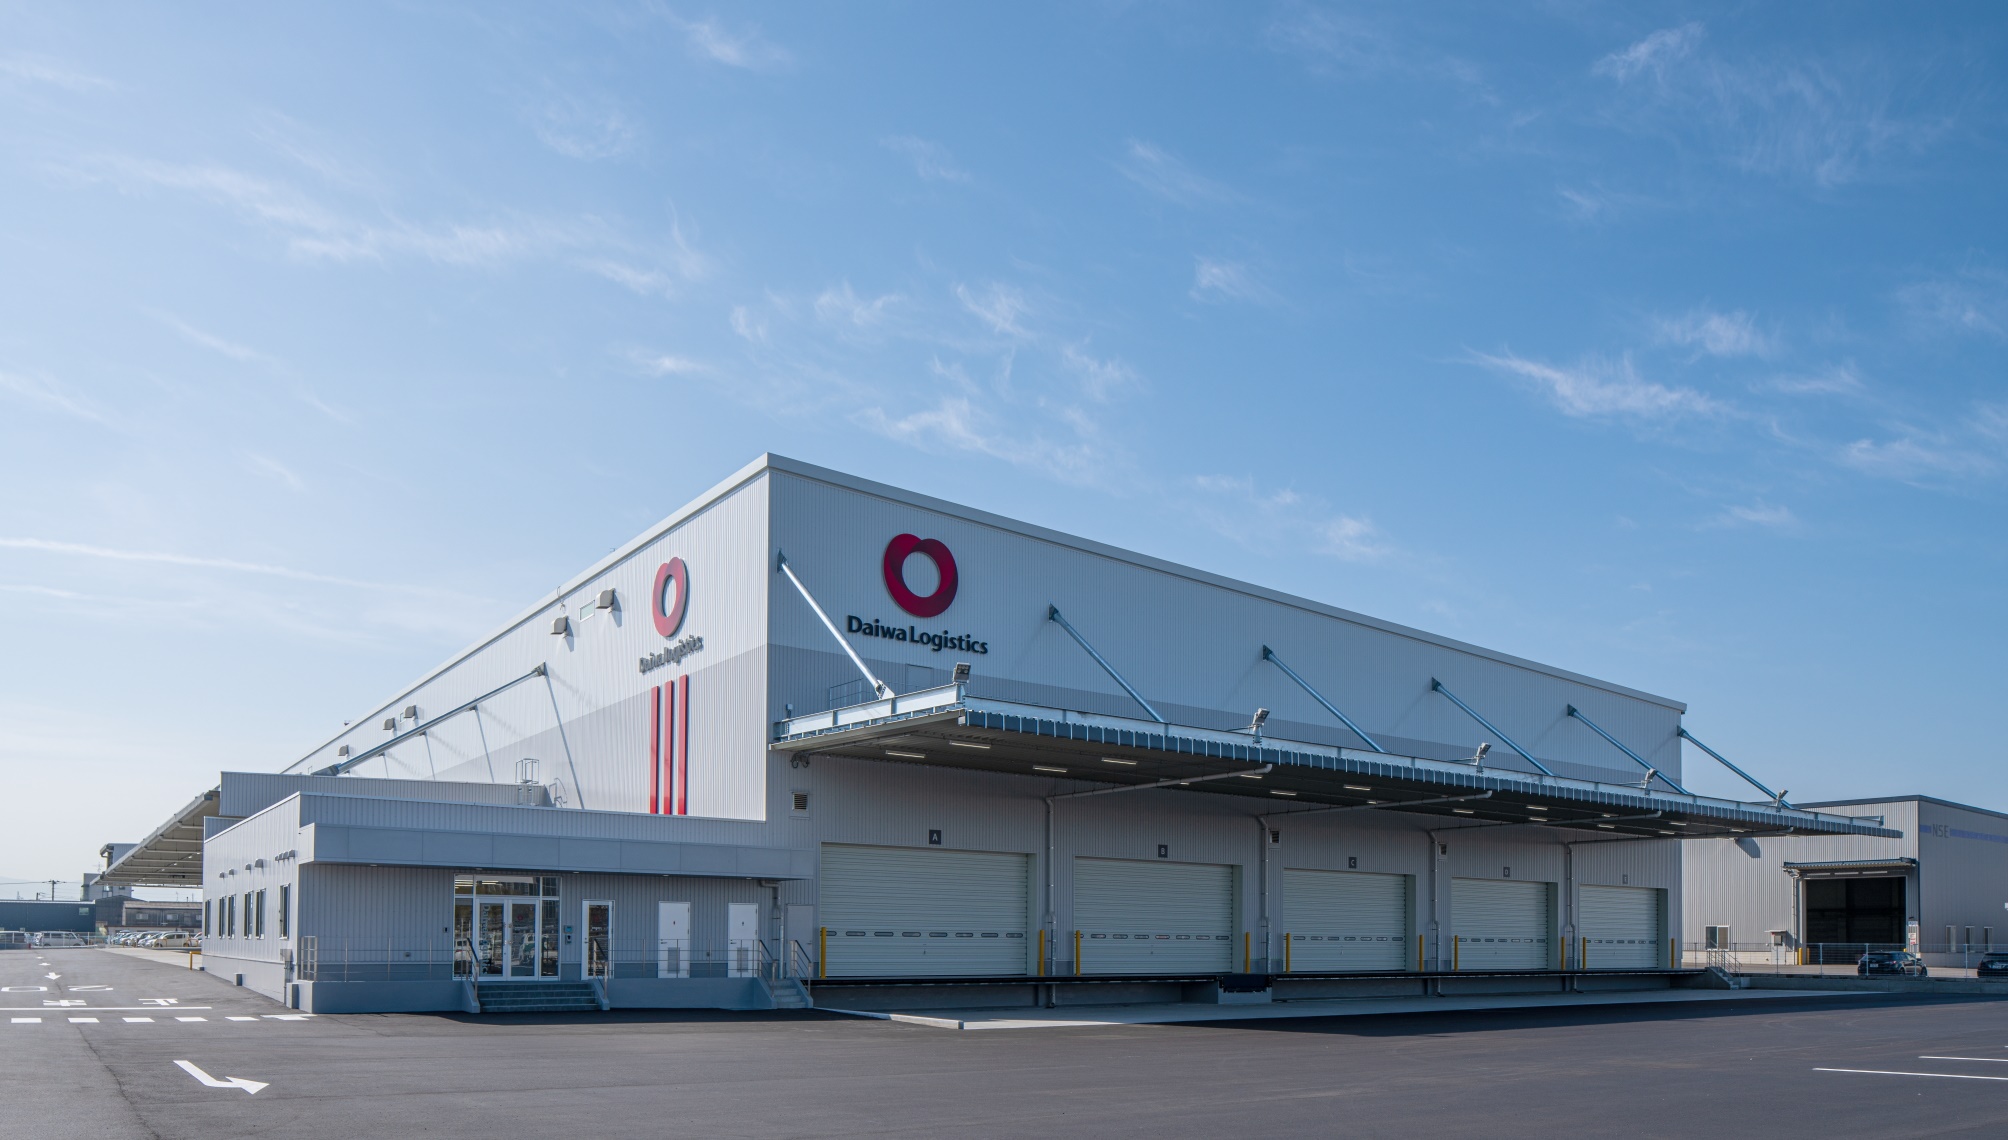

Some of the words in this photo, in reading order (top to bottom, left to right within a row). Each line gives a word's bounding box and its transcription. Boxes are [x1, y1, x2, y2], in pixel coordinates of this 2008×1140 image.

[847, 615, 907, 641] Daiwa
[909, 626, 988, 654] Logistics
[932, 833, 938, 841] A
[1932, 823, 1950, 839] NSE
